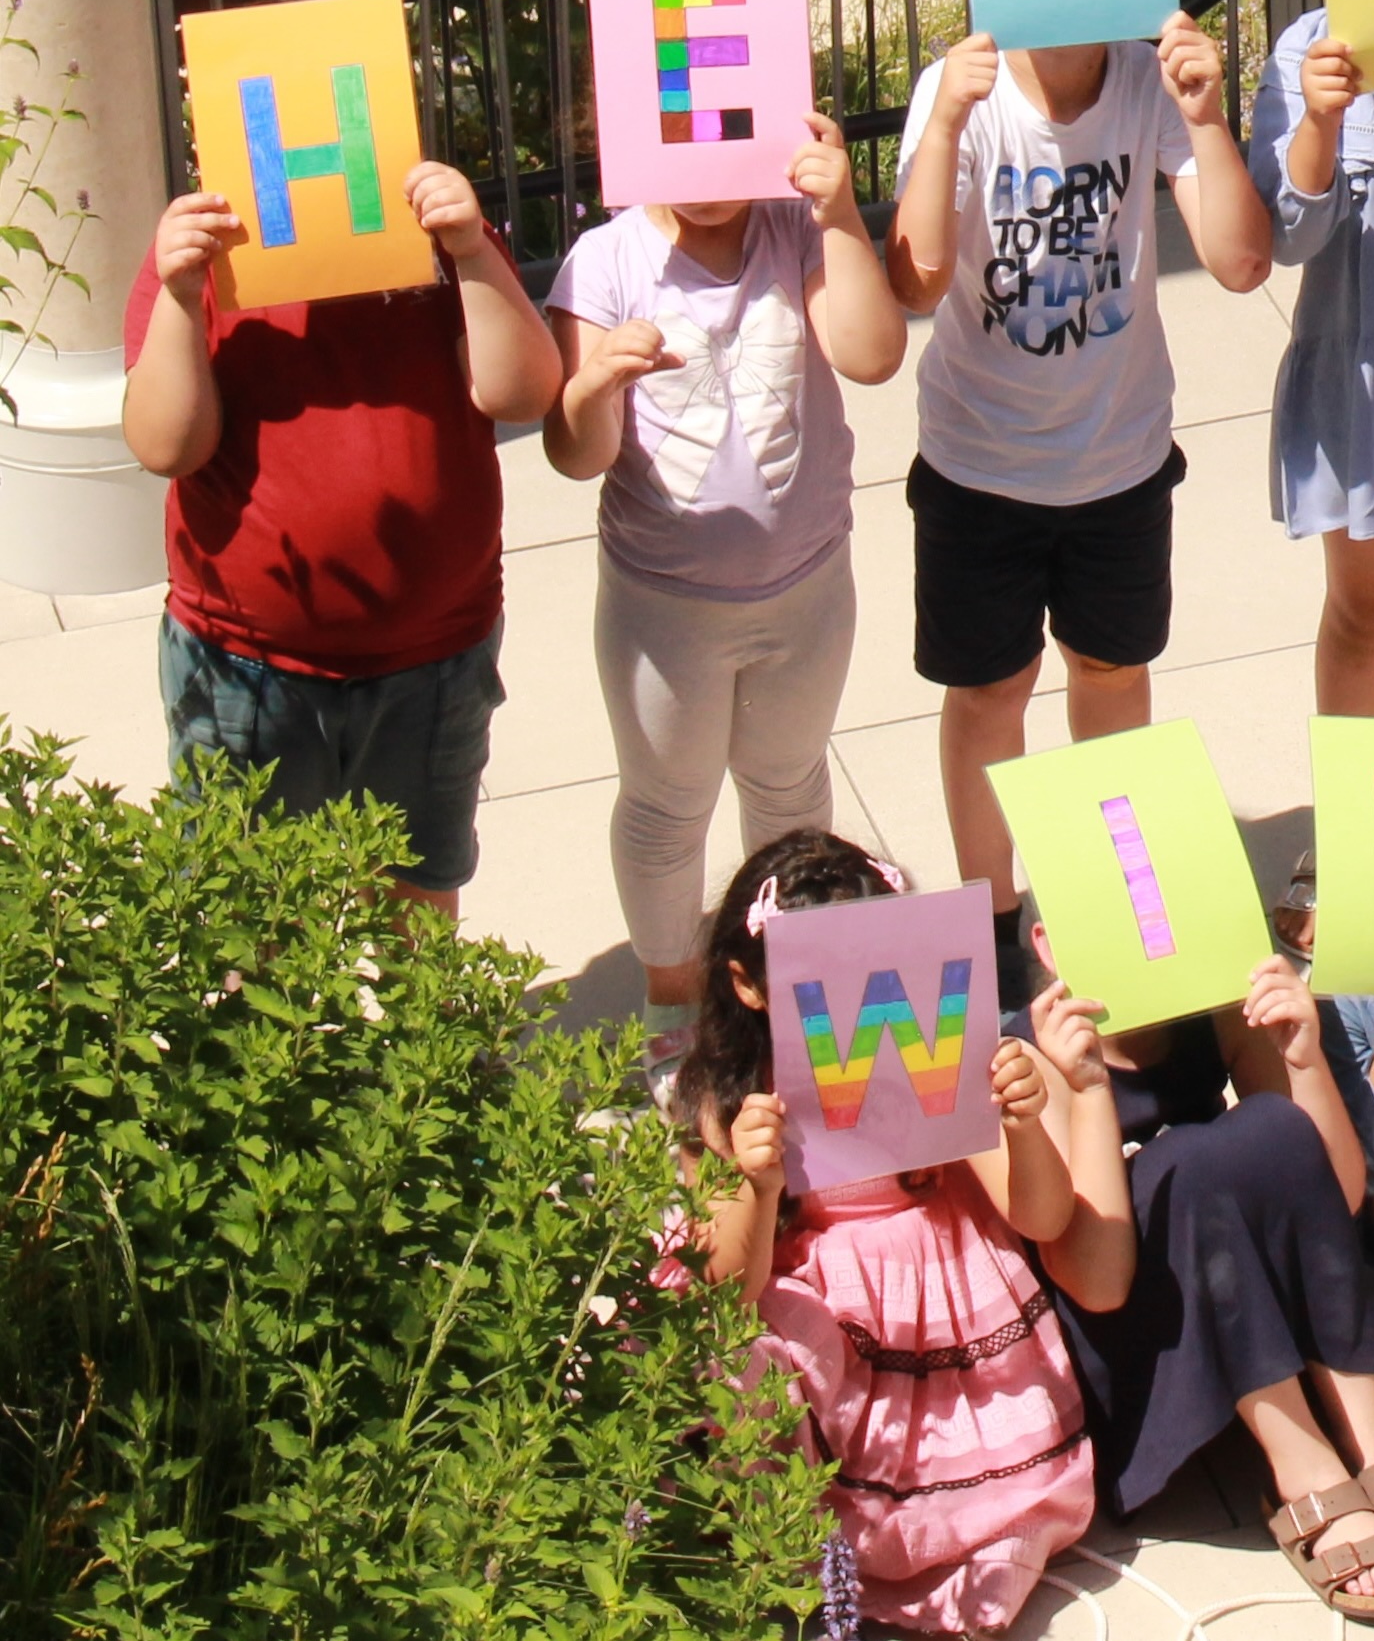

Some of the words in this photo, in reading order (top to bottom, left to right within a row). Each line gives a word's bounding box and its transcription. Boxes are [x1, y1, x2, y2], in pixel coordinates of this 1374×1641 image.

[238, 63, 385, 248] H
[990, 153, 1132, 222] BORN
[993, 217, 1041, 257] TO
[1048, 215, 1100, 255] BE
[1098, 794, 1177, 962] I
[792, 958, 973, 1132] W
